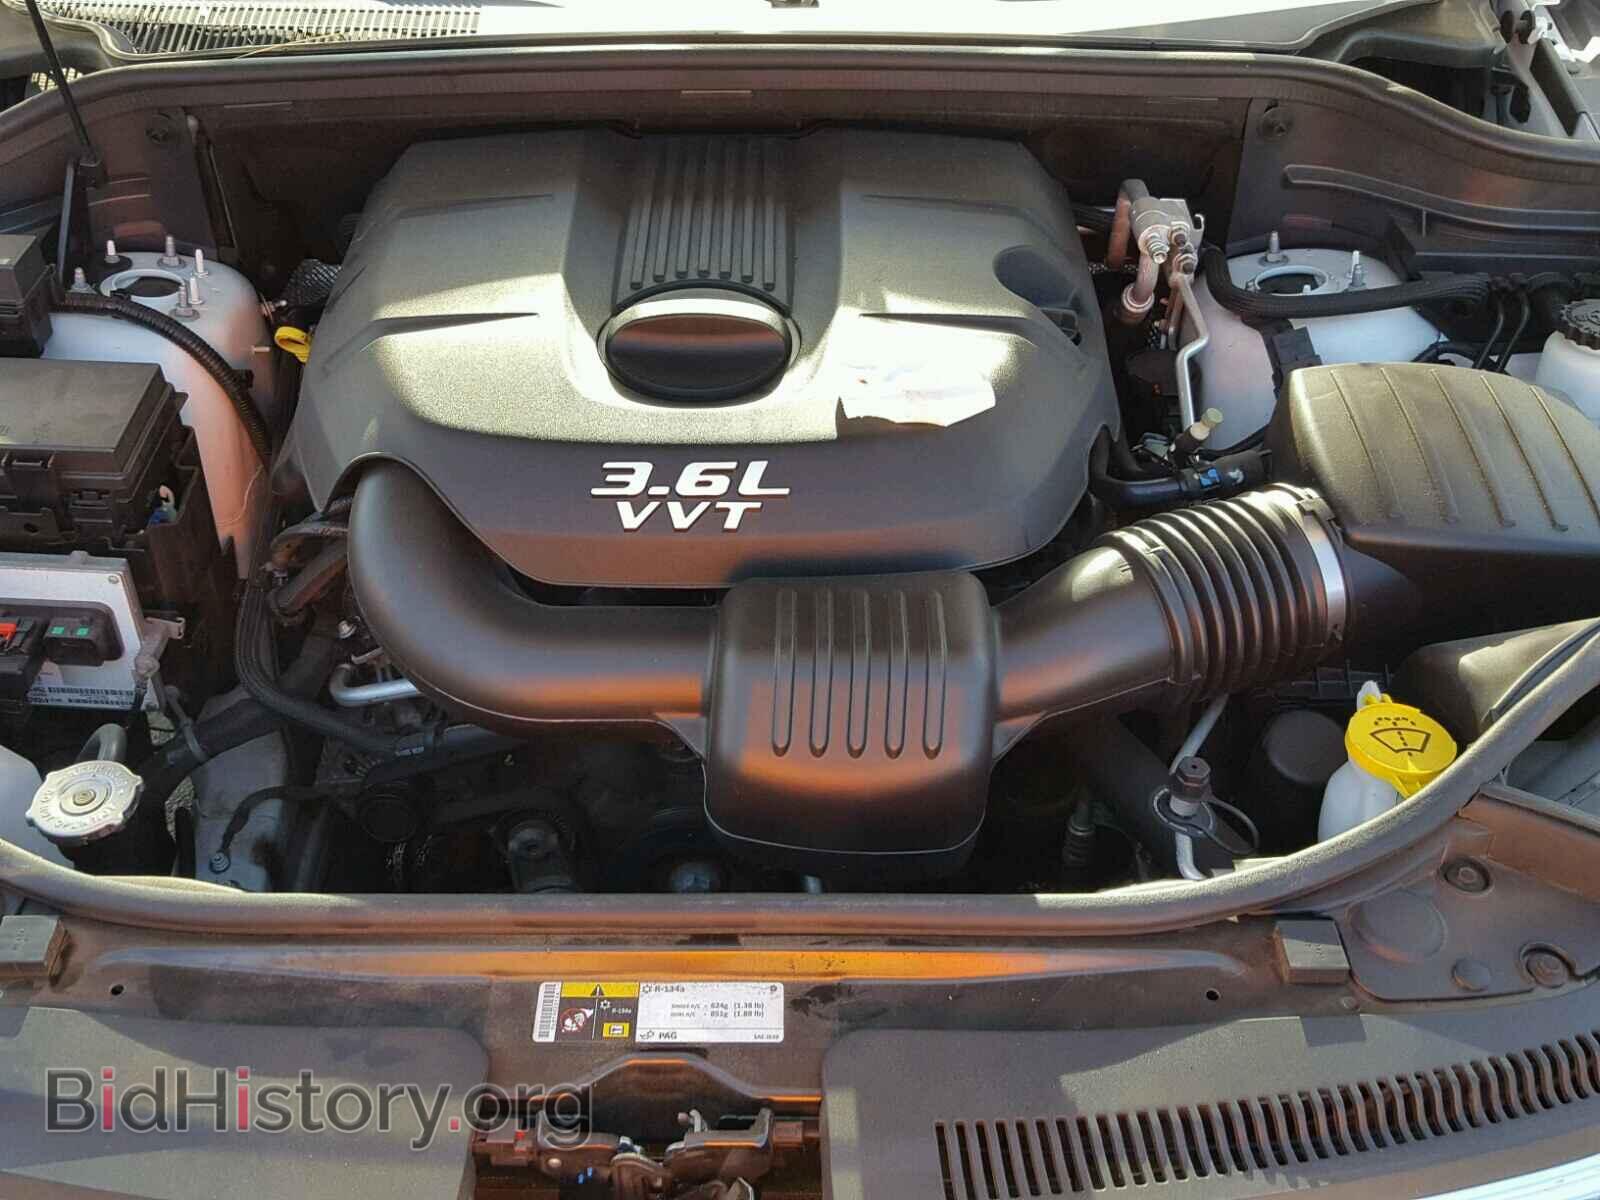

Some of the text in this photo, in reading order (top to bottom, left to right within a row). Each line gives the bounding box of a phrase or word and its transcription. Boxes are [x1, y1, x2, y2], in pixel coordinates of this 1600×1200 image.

[590, 460, 791, 497] 3.6L
[616, 501, 763, 531] VVT
[658, 1031, 678, 1040] PAG
